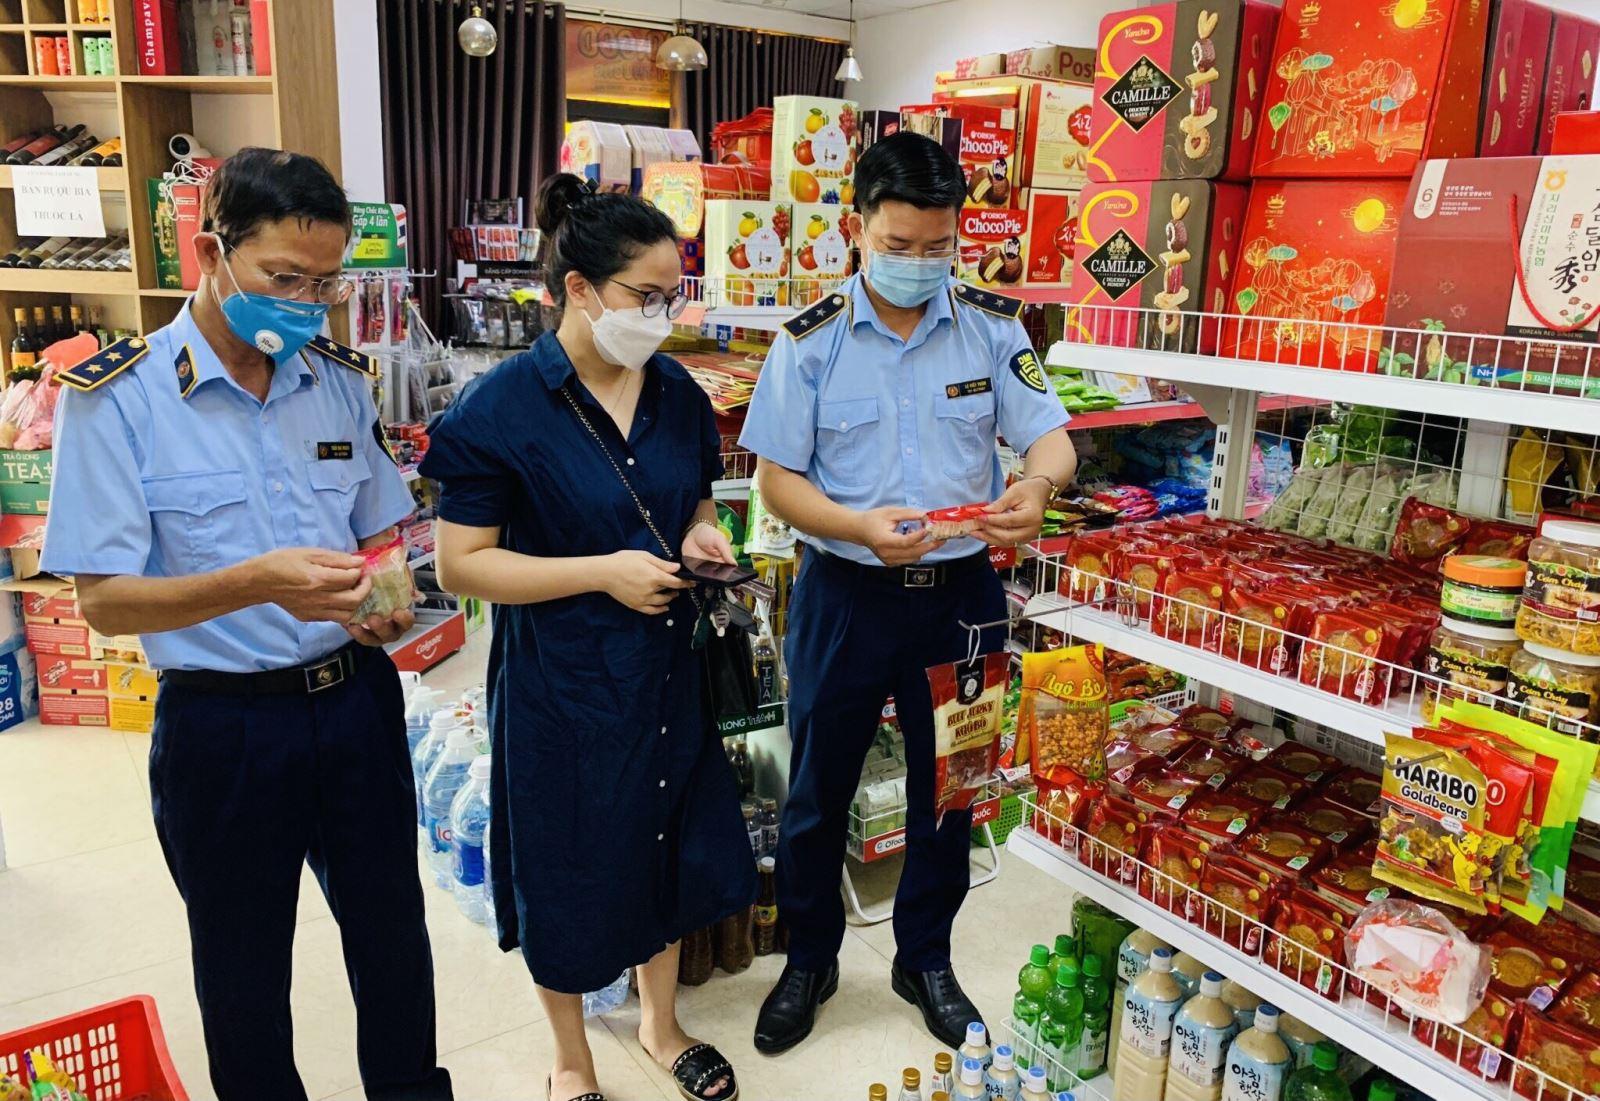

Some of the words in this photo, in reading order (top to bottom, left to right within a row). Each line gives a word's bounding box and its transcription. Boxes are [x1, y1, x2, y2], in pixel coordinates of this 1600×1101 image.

[1111, 85, 1171, 105] CAMILLE
[1516, 57, 1533, 128] CAMILLE
[1421, 188, 1434, 202] 6
[369, 215, 375, 226] 4
[1091, 259, 1146, 274] CAMILLE
[1548, 256, 1581, 294] 秀
[1519, 328, 1542, 336] KOREAN
[1477, 368, 1494, 377] NH
[761, 666, 772, 698] TEA
[722, 718, 746, 731] LONG
[1395, 756, 1478, 807] HARIBO
[1401, 785, 1469, 820] Goldbears
[1126, 999, 1149, 1024] 아침
[1131, 1015, 1154, 1037] 햇살
[1175, 1025, 1200, 1050] 아침
[1181, 1041, 1204, 1064] 햇살
[1231, 1063, 1261, 1088] 아침
